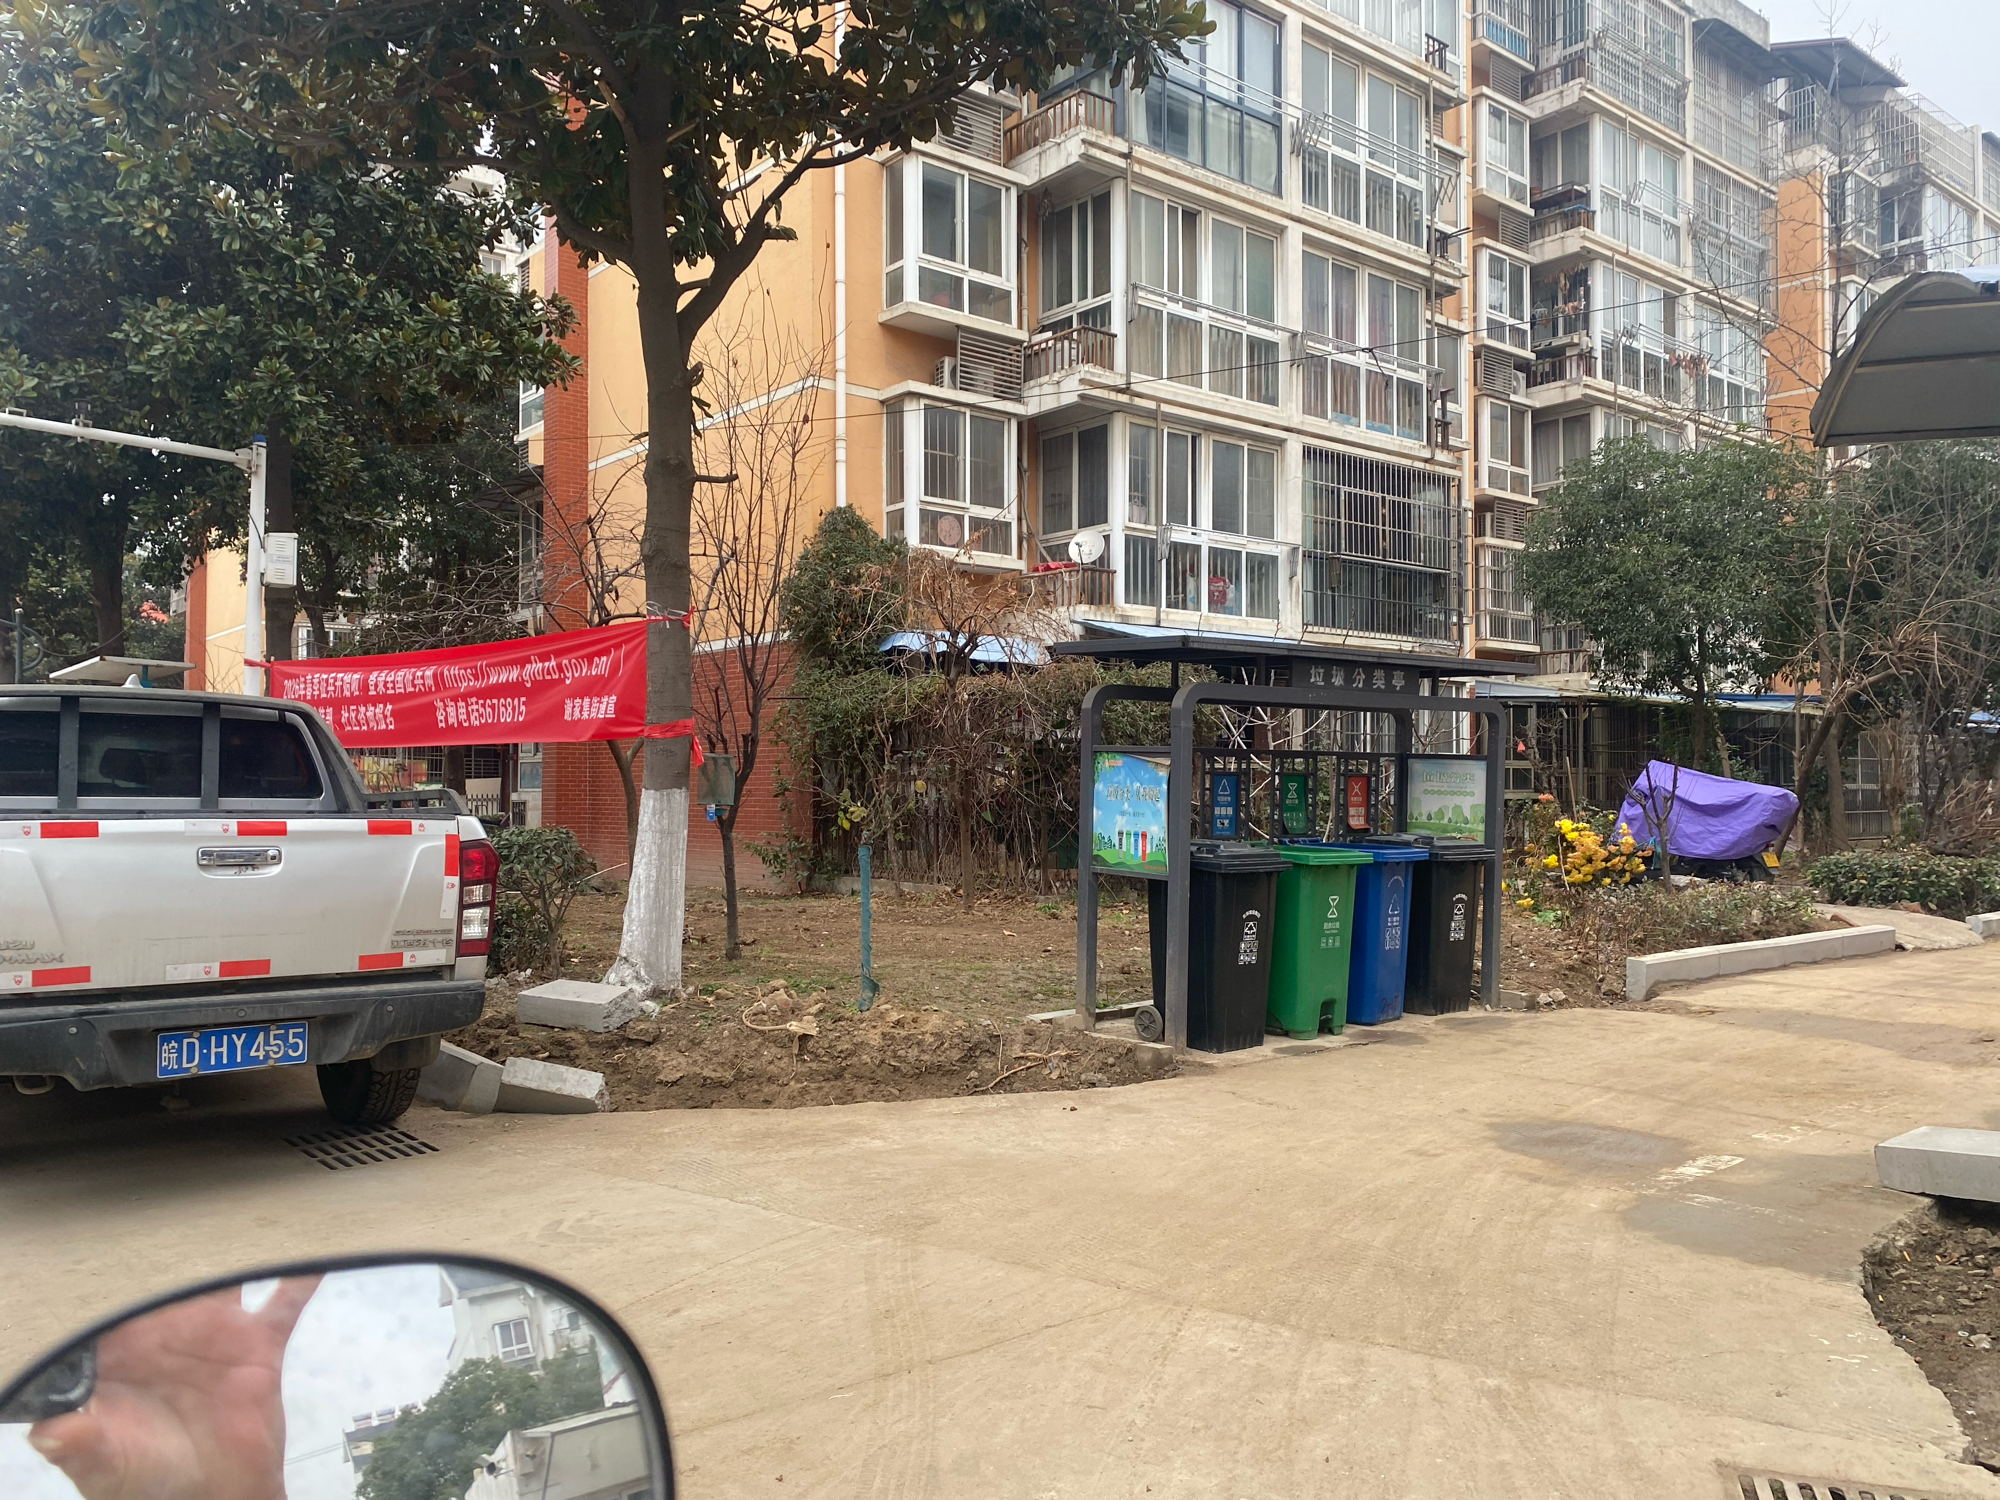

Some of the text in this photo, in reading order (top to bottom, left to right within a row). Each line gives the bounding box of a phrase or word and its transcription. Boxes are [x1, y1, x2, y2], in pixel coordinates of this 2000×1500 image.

[1309, 665, 1405, 691] 垃圾分类亭
[433, 697, 526, 729] 咨询电话5676815
[563, 694, 617, 722] 谢家集街道宣
